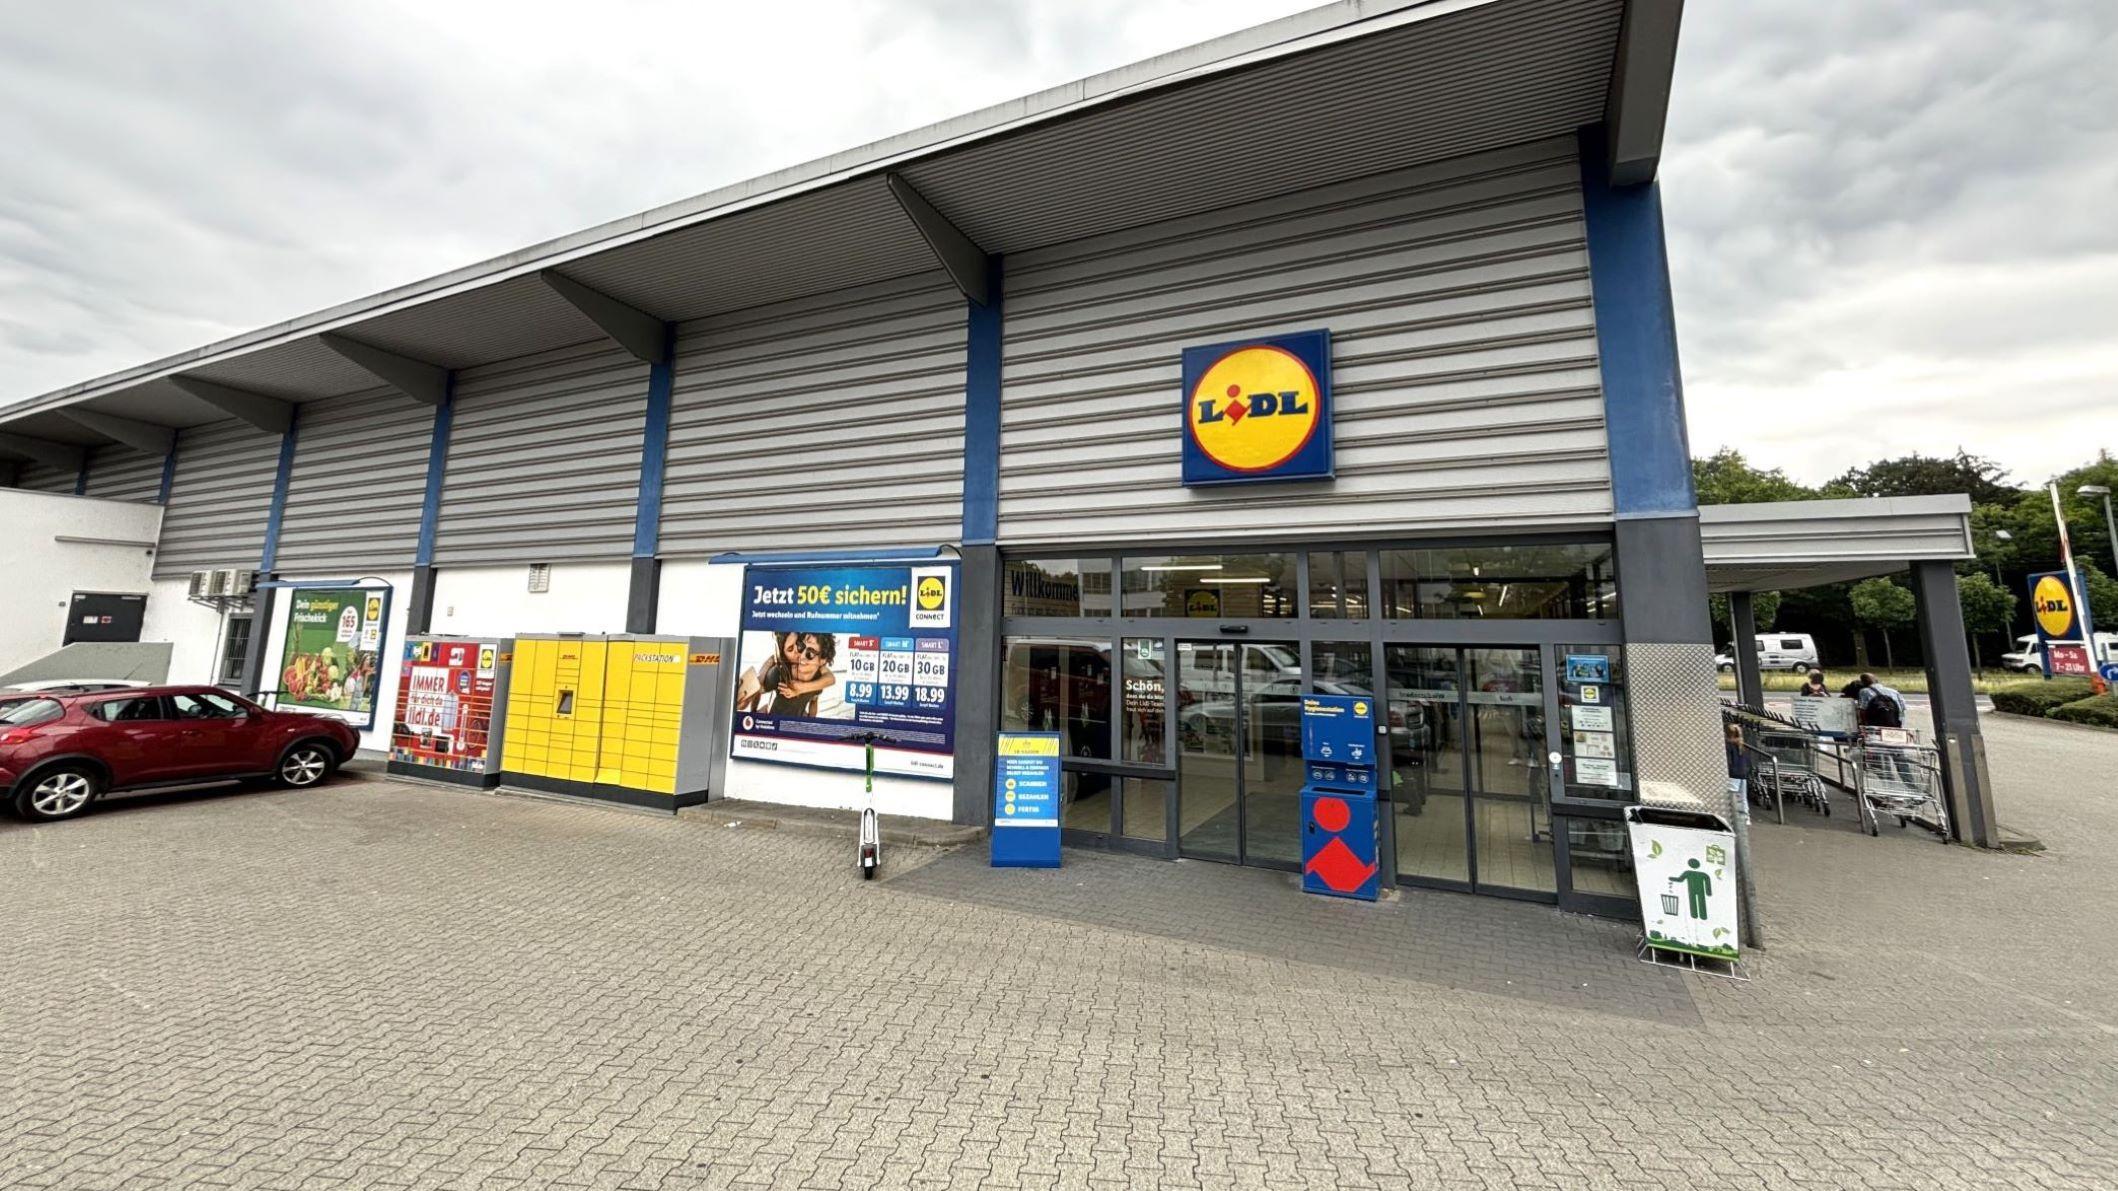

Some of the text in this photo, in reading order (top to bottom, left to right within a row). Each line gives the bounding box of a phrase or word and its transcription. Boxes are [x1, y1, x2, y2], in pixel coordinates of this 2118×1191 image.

[1198, 384, 1308, 426] LIDL
[753, 584, 907, 605] Jetzt 50€ sichern!
[920, 586, 942, 598] LIDL
[2035, 596, 2068, 615] LIDL
[767, 611, 794, 619] wechseln
[807, 612, 842, 620] Rufnummer
[634, 653, 675, 663] PACKSTATION
[2054, 650, 2065, 658] Mo
[2069, 651, 2078, 659] Sa
[850, 659, 875, 671] 10 GB
[882, 660, 910, 673] 20 GB
[917, 661, 945, 675] 30 GB
[2073, 663, 2085, 672] Uhr
[413, 675, 446, 692] IMMER
[849, 683, 873, 698] 8.99
[1126, 680, 1165, 694] Schön,
[881, 685, 909, 701] 13.99
[915, 687, 945, 703] 18.99
[407, 704, 441, 726] lidl.de
